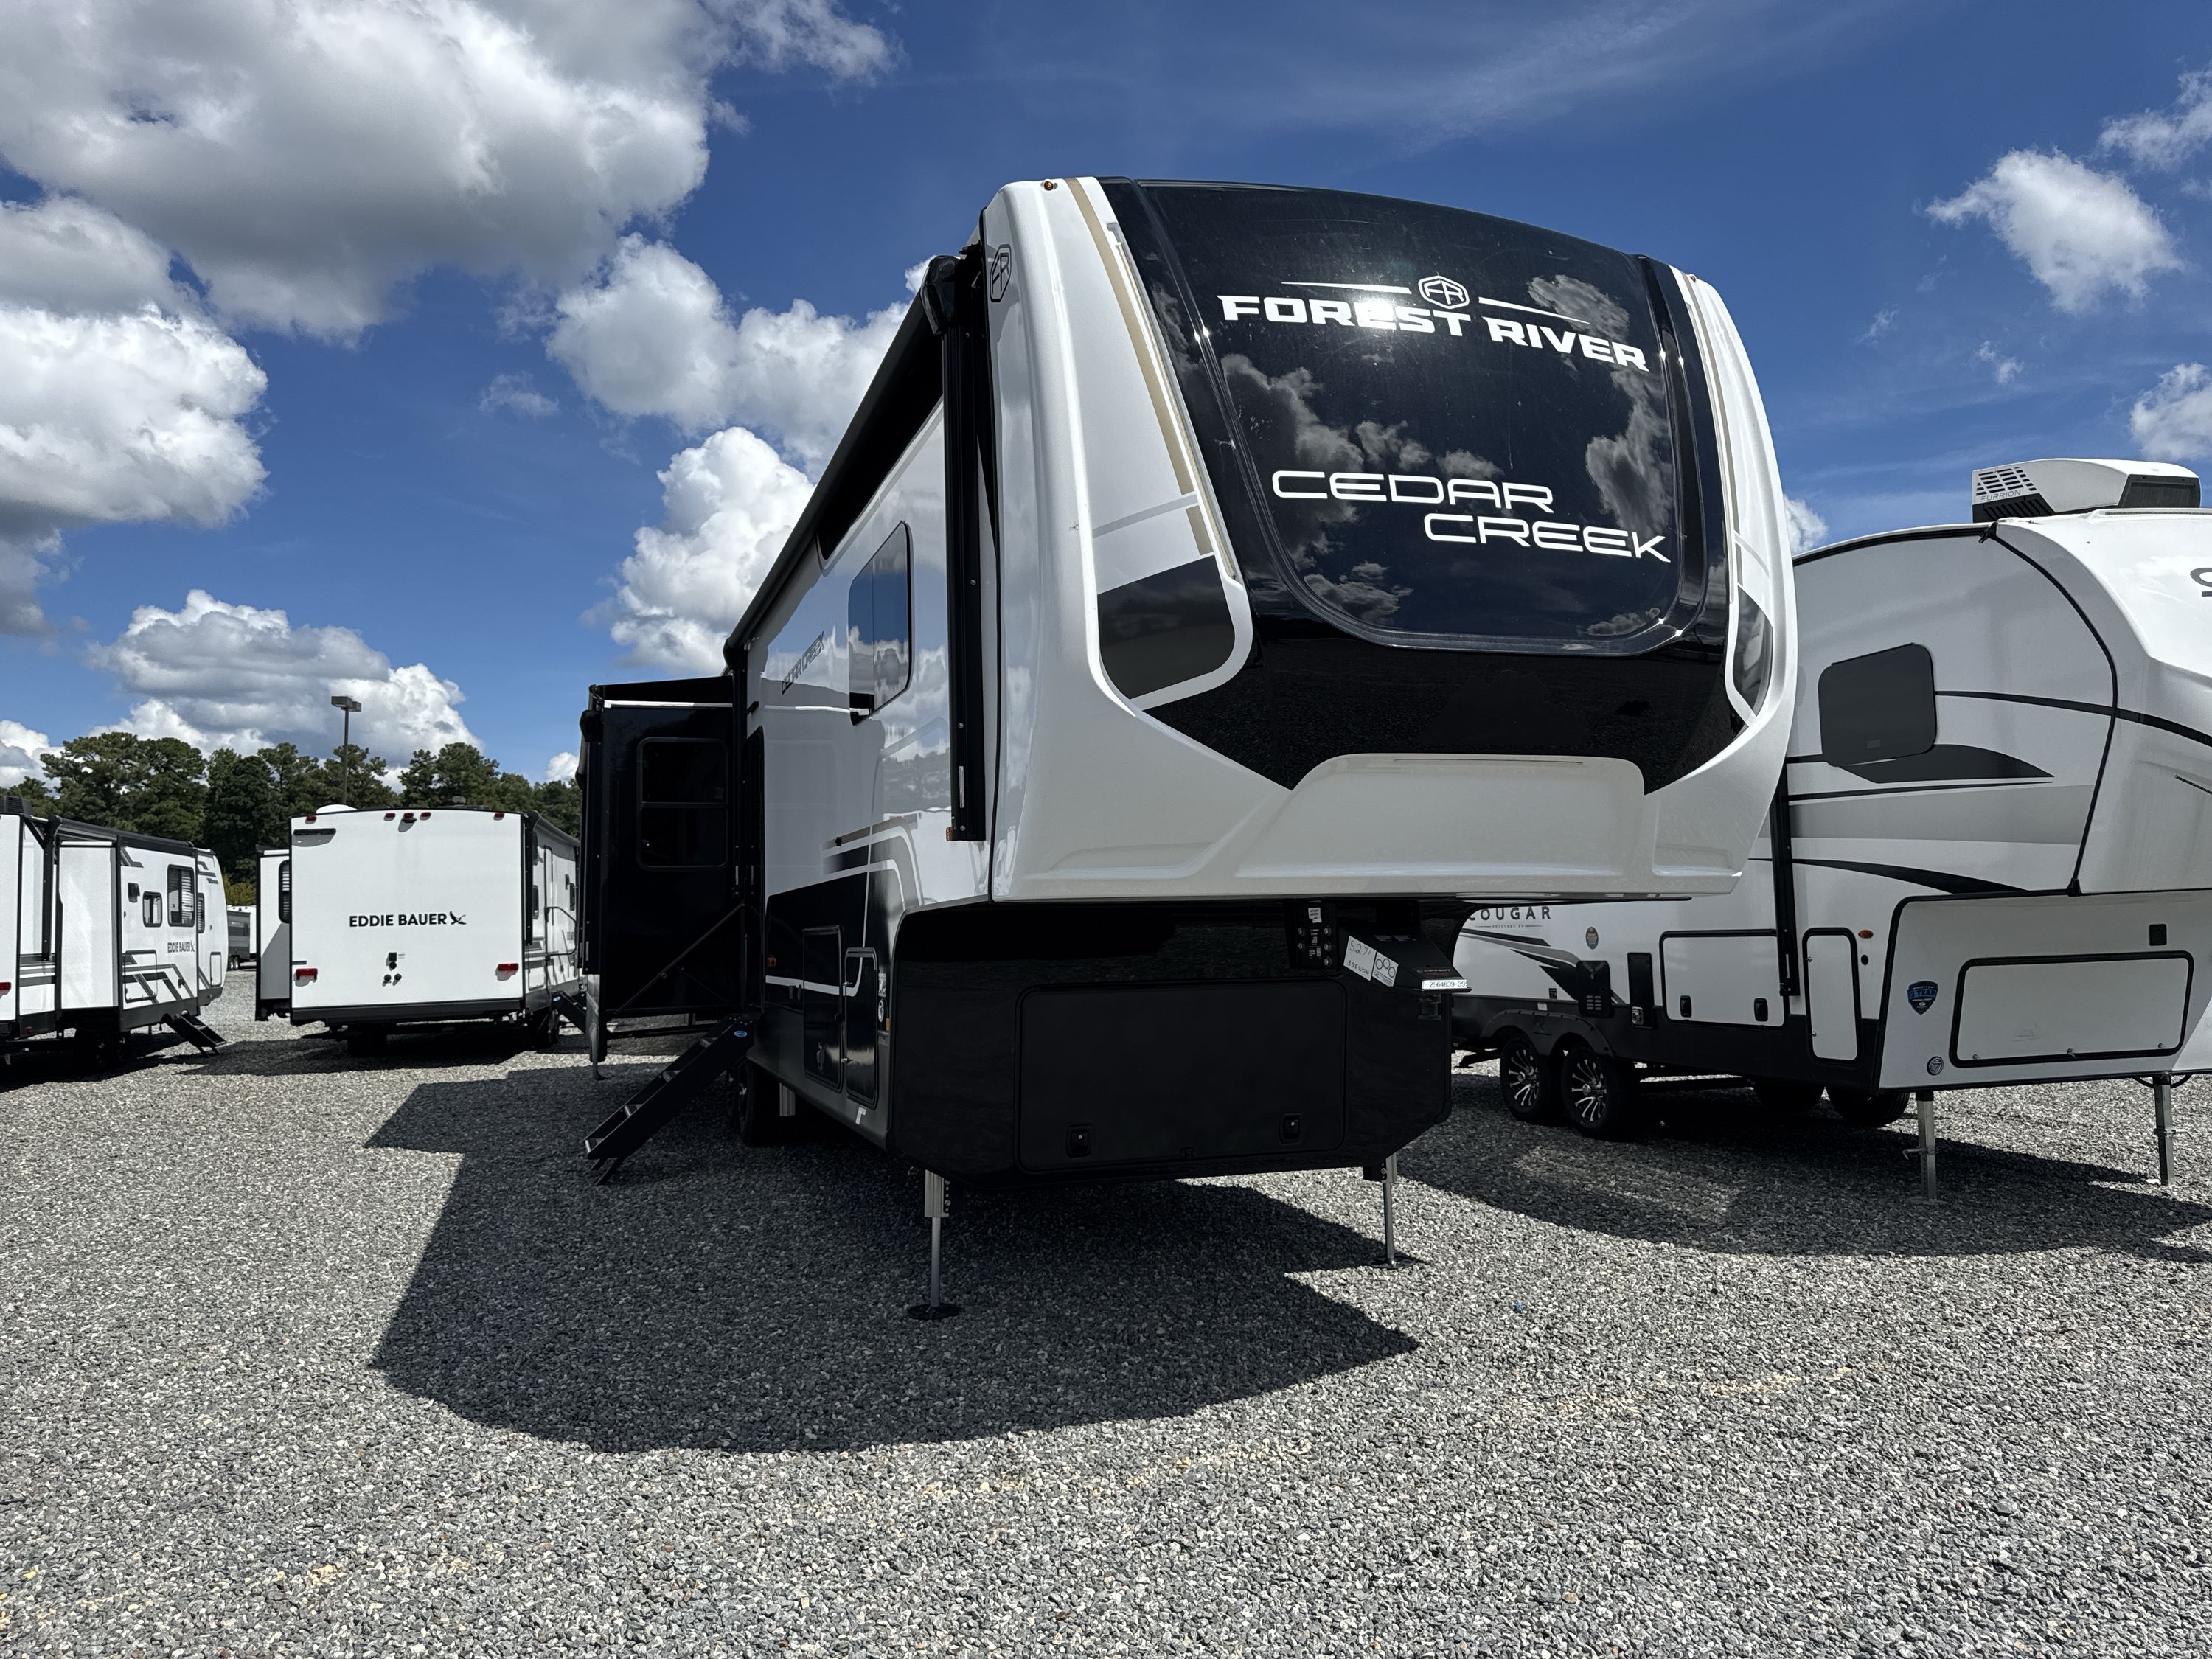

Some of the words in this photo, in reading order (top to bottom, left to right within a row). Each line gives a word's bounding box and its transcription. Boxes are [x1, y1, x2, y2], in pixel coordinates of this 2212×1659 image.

[1217, 295, 1472, 336] FOREST
[1481, 314, 1650, 372] RIVER
[1272, 470, 1554, 513] CEDAR
[1424, 512, 1671, 563] CREEK
[349, 914, 394, 928] EDDIE
[397, 913, 448, 926] BAUER
